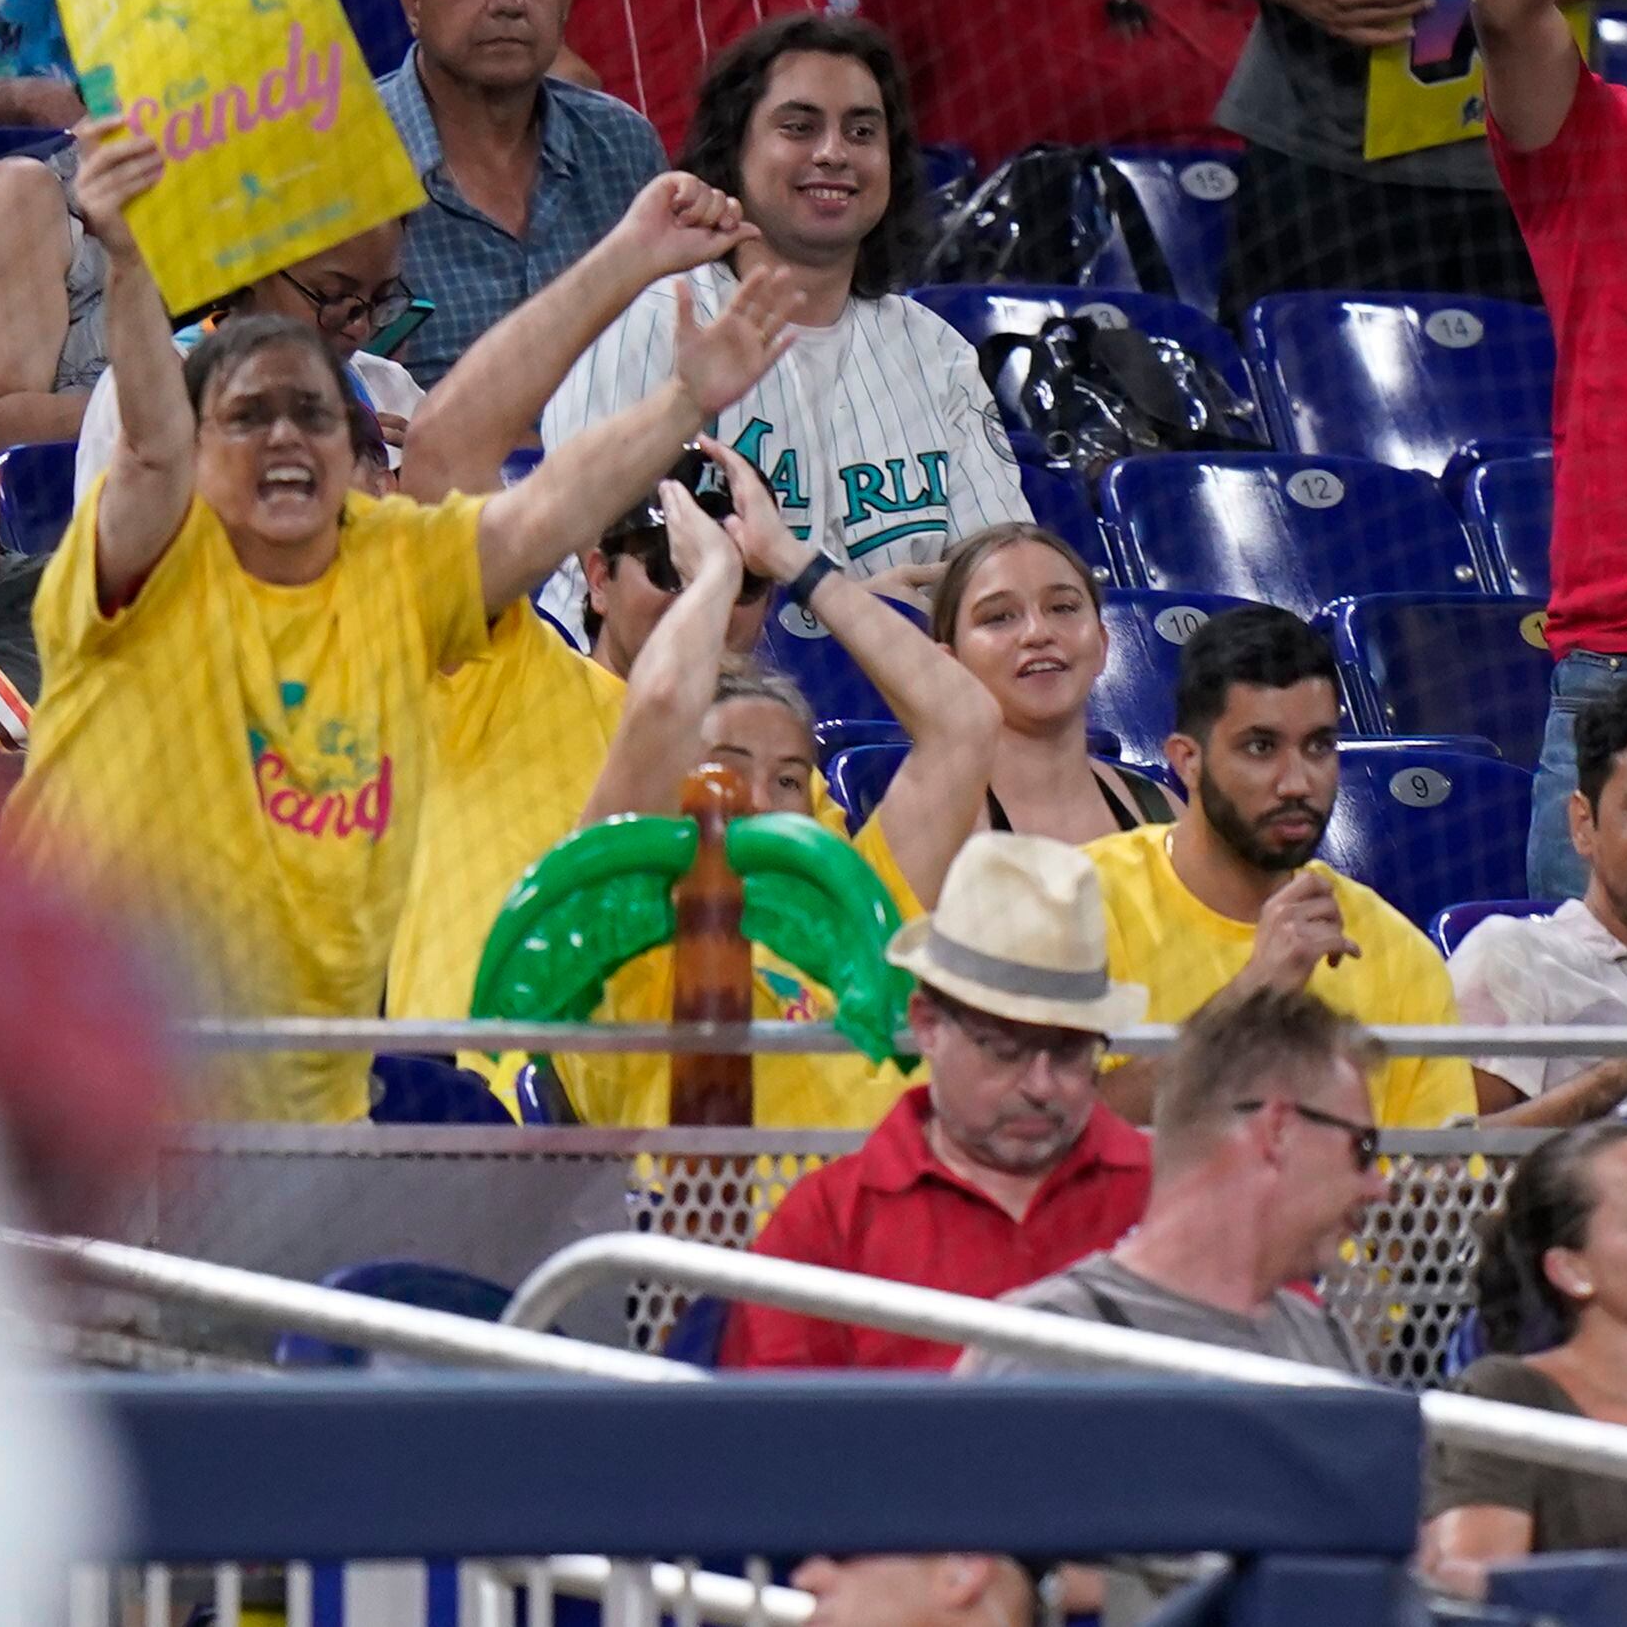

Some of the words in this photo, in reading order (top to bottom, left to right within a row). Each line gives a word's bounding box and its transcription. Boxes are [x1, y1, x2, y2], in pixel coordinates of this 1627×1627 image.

[1300, 475, 1332, 501] 12
[1169, 612, 1200, 638] 10
[1411, 774, 1430, 799] 9
